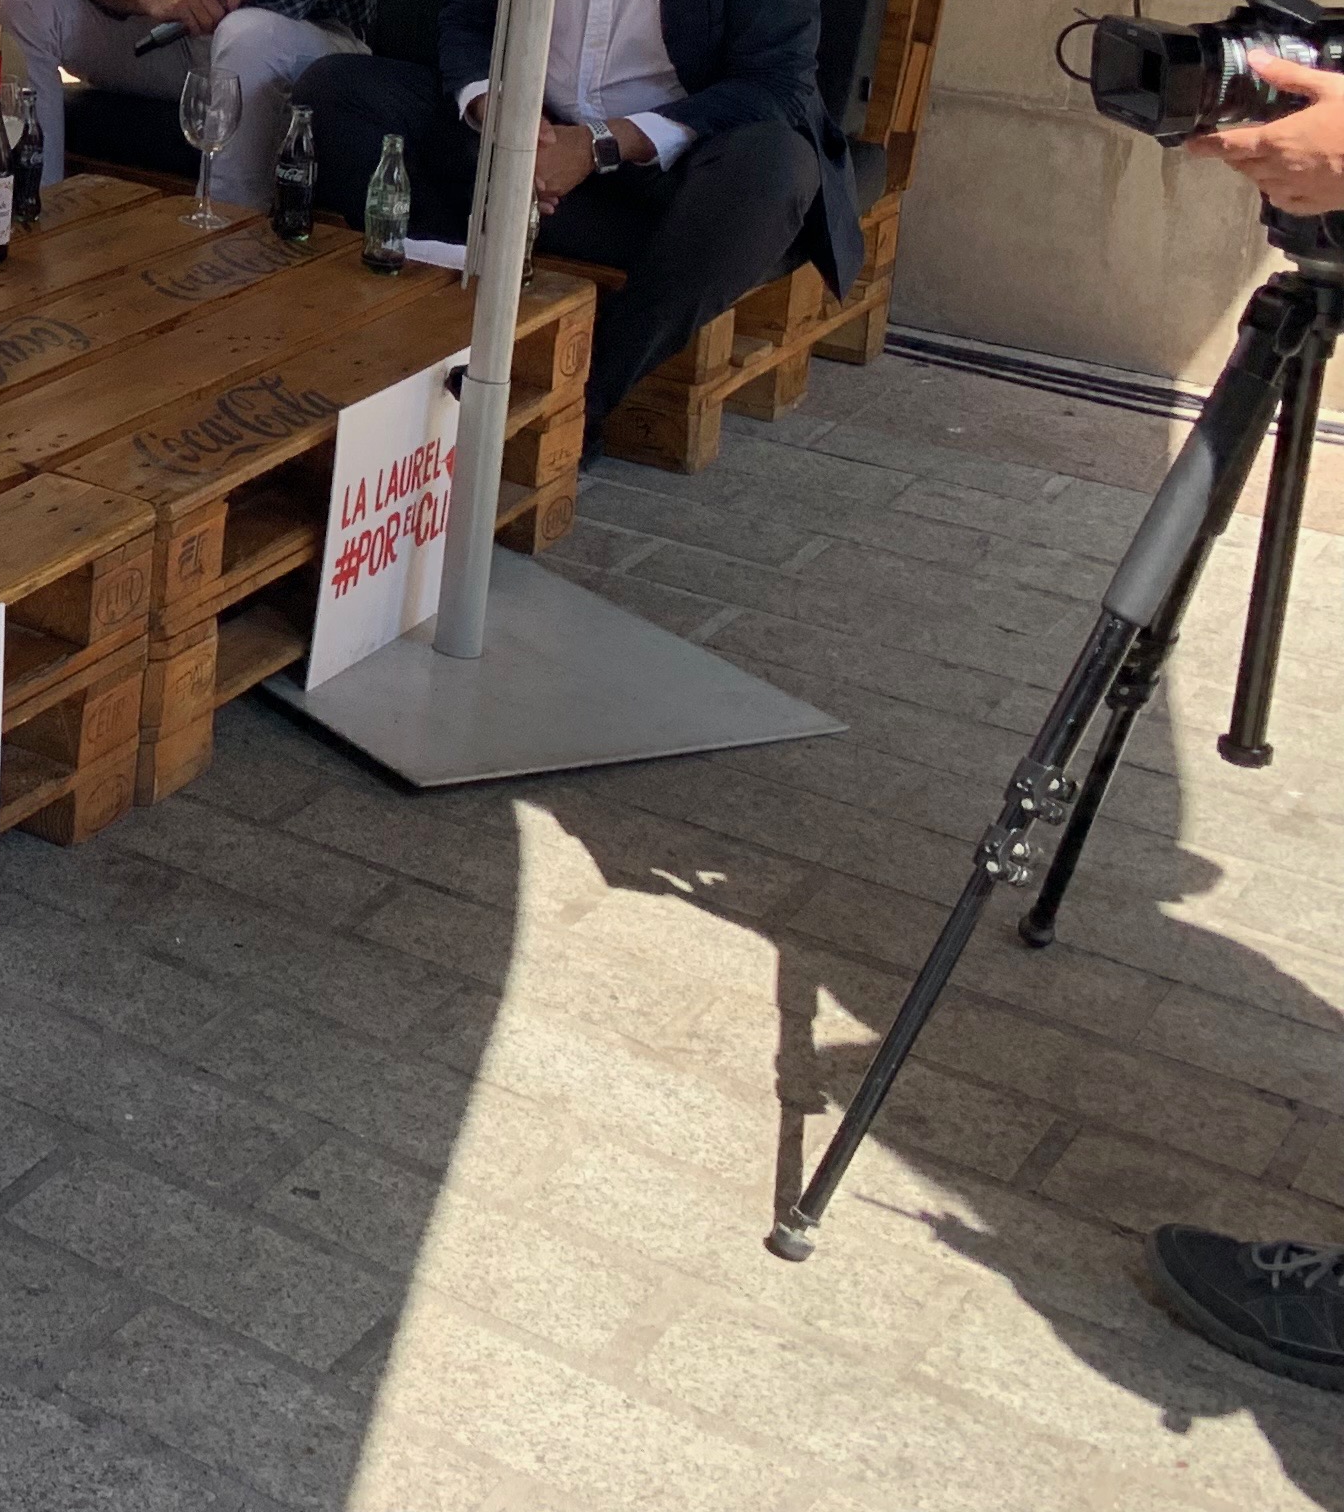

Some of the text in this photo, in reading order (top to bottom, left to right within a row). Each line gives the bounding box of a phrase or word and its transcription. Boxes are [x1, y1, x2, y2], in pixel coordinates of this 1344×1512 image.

[340, 437, 442, 531] LA LAUREL
[331, 511, 401, 600] #POR
[413, 490, 451, 548] CLI
